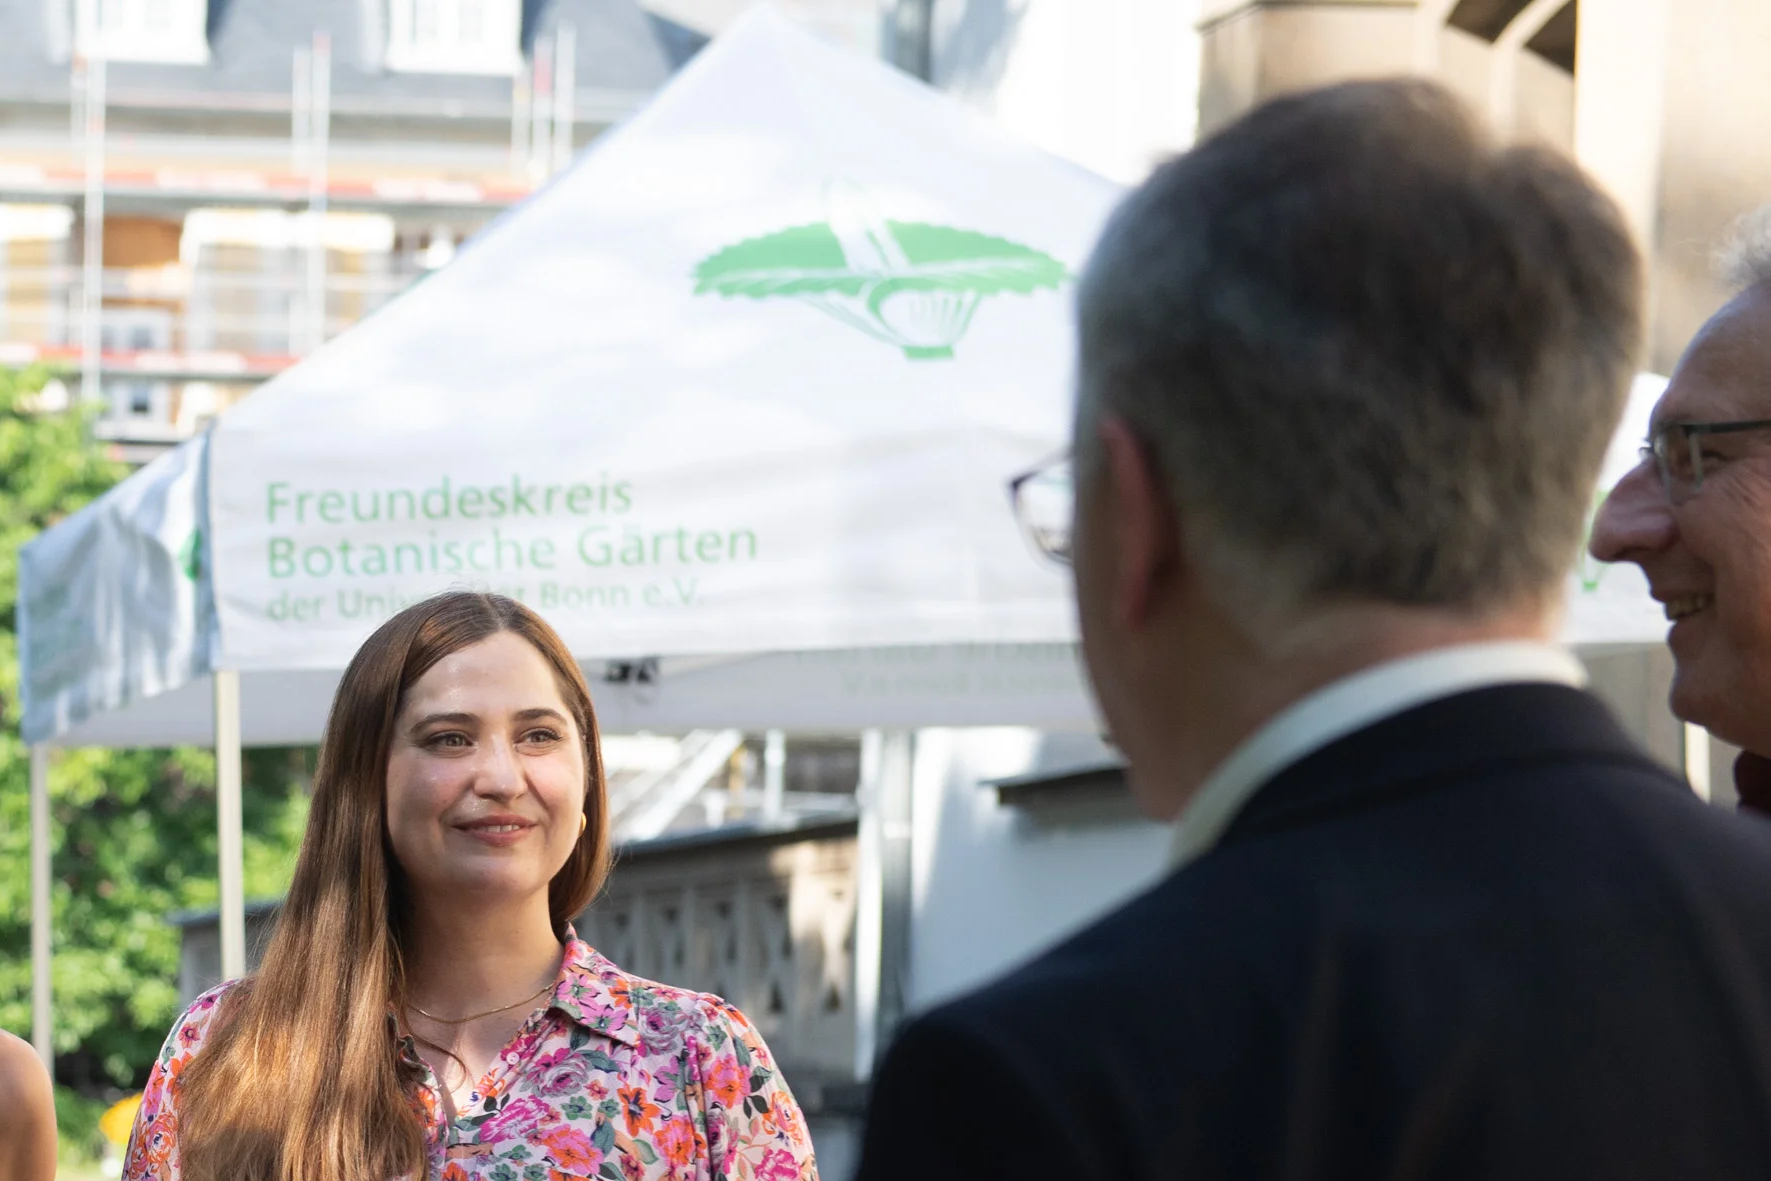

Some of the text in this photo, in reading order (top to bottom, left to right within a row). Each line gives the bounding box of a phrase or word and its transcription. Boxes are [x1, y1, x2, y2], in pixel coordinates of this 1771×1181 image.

[266, 473, 633, 522] Freundeskreis
[266, 523, 759, 579] Botanische Gärten
[265, 589, 325, 622] der
[539, 580, 629, 611] Bonn
